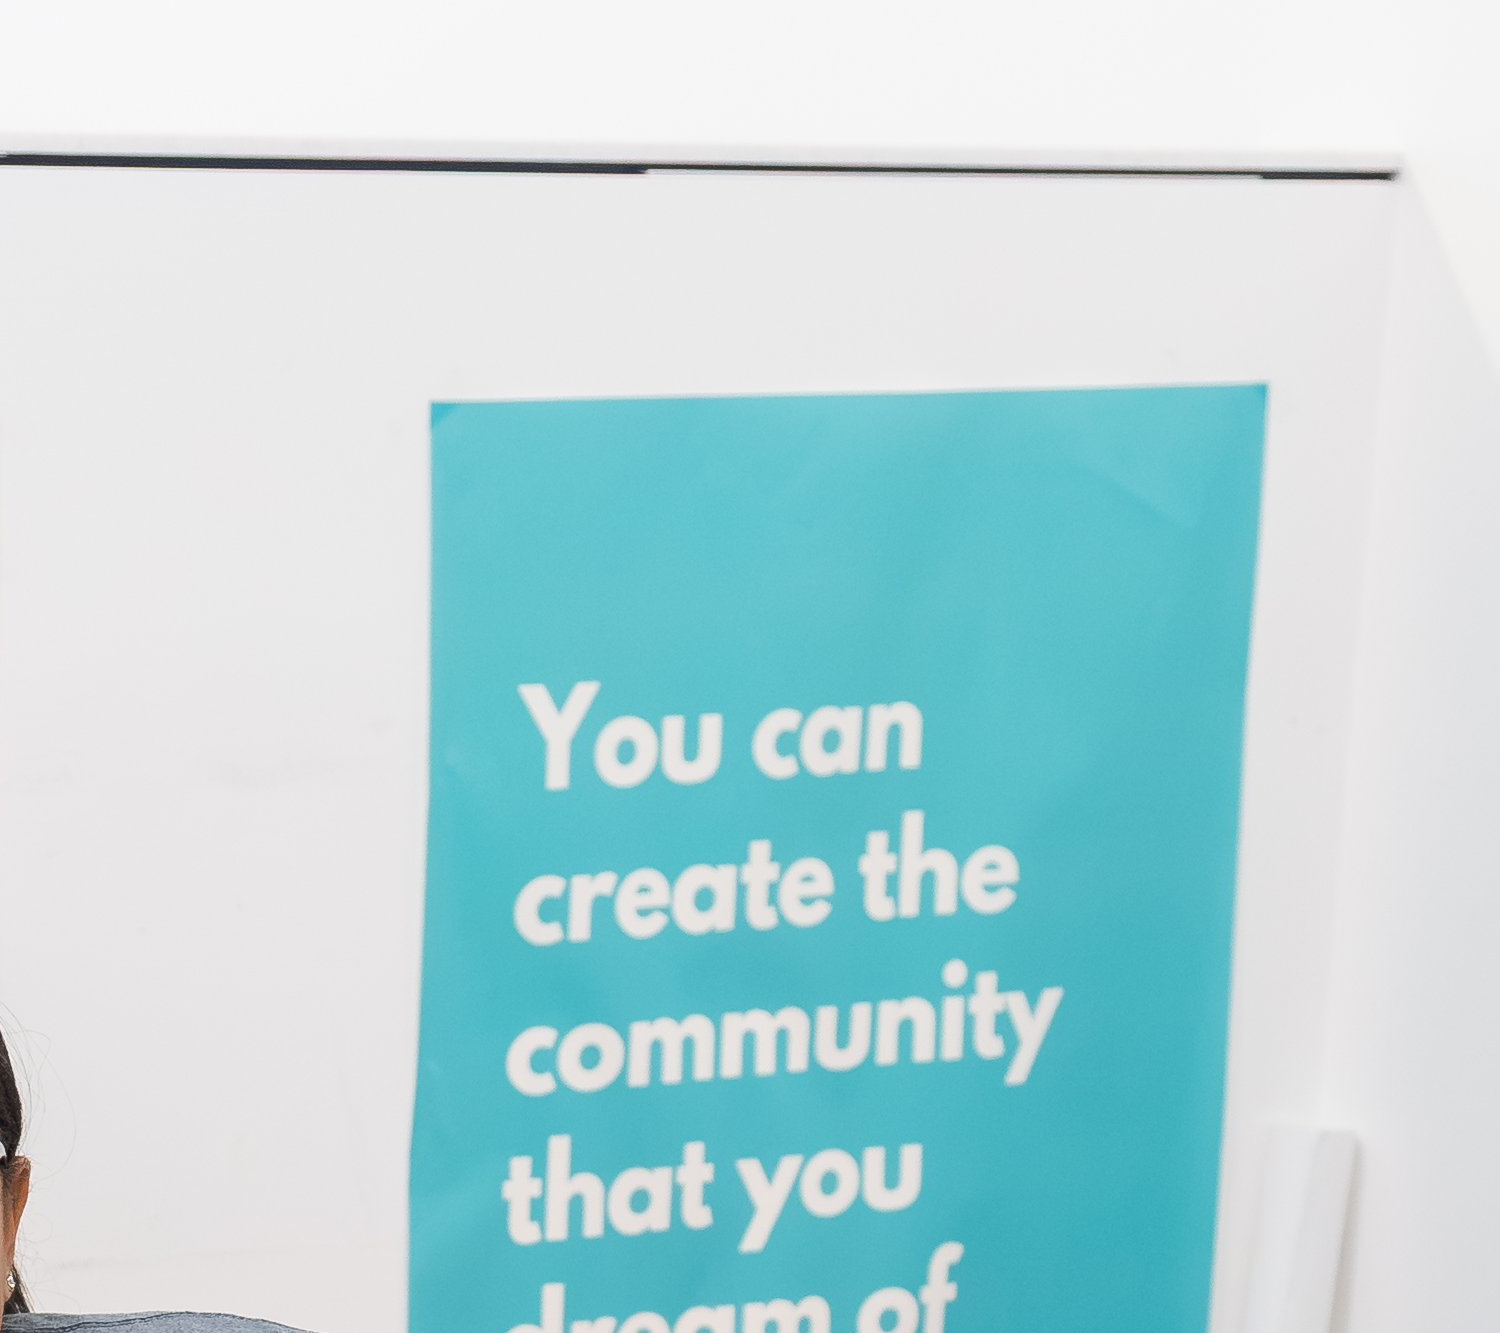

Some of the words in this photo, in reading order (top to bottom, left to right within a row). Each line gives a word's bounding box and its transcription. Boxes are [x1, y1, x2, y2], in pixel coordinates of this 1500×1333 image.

[517, 681, 723, 791] You
[752, 700, 923, 780] can
[512, 839, 834, 946] create
[858, 809, 1020, 922] the
[505, 959, 1065, 1097] community
[503, 1134, 714, 1246] that
[736, 1143, 923, 1254] you
